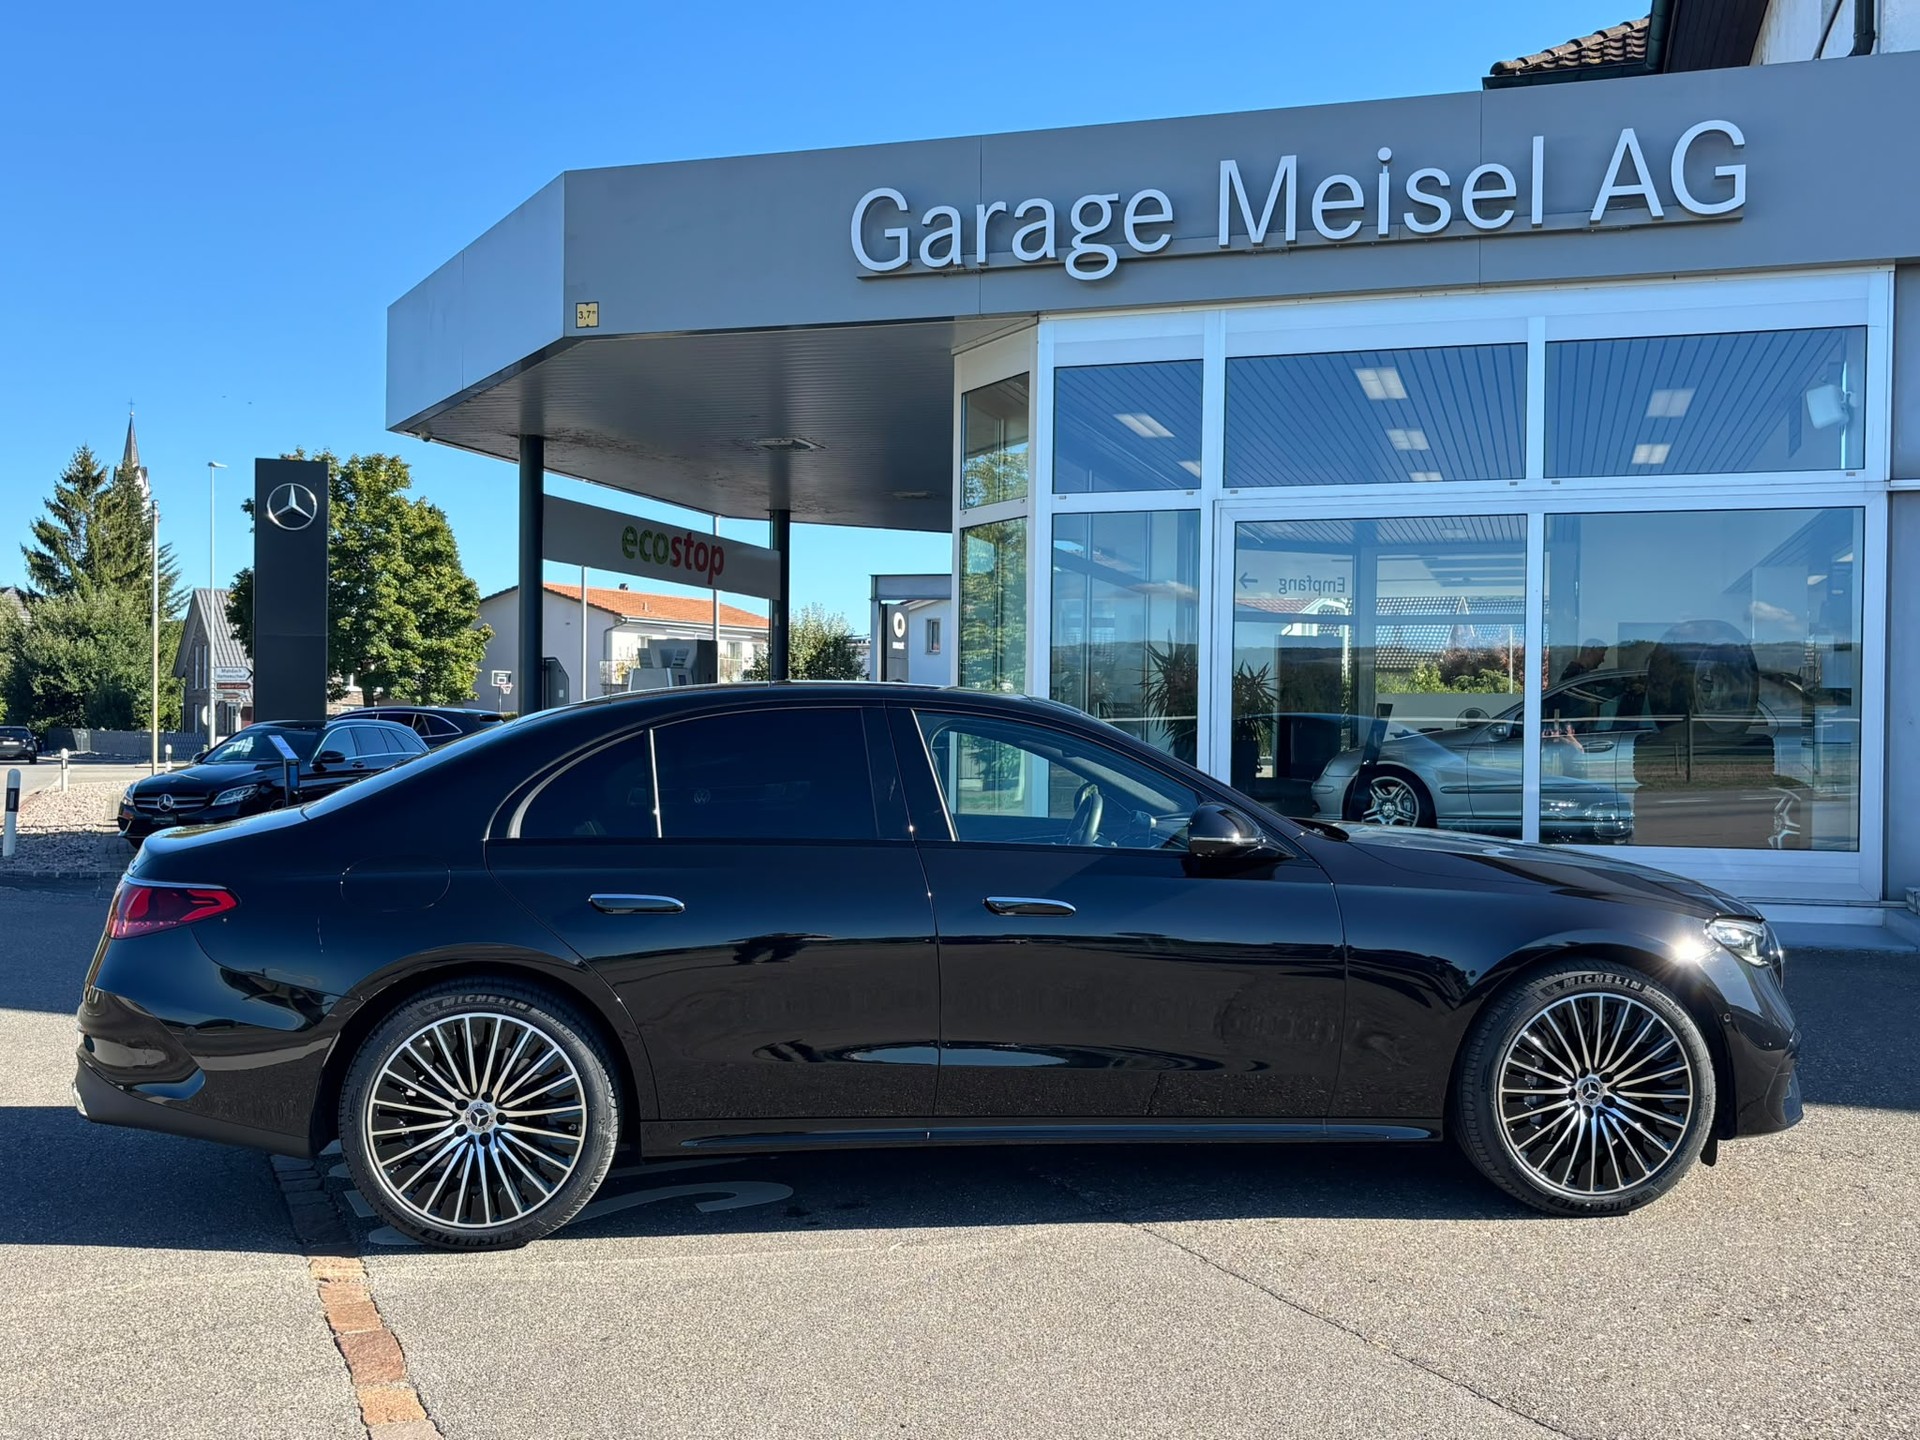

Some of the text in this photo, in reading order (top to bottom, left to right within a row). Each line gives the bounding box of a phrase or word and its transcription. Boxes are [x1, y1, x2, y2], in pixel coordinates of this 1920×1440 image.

[851, 119, 1747, 280] Garage Meisel AG
[621, 525, 725, 585] ecostop
[1563, 973, 1642, 990] MICHELIN
[442, 994, 528, 1011] MICHELIN
